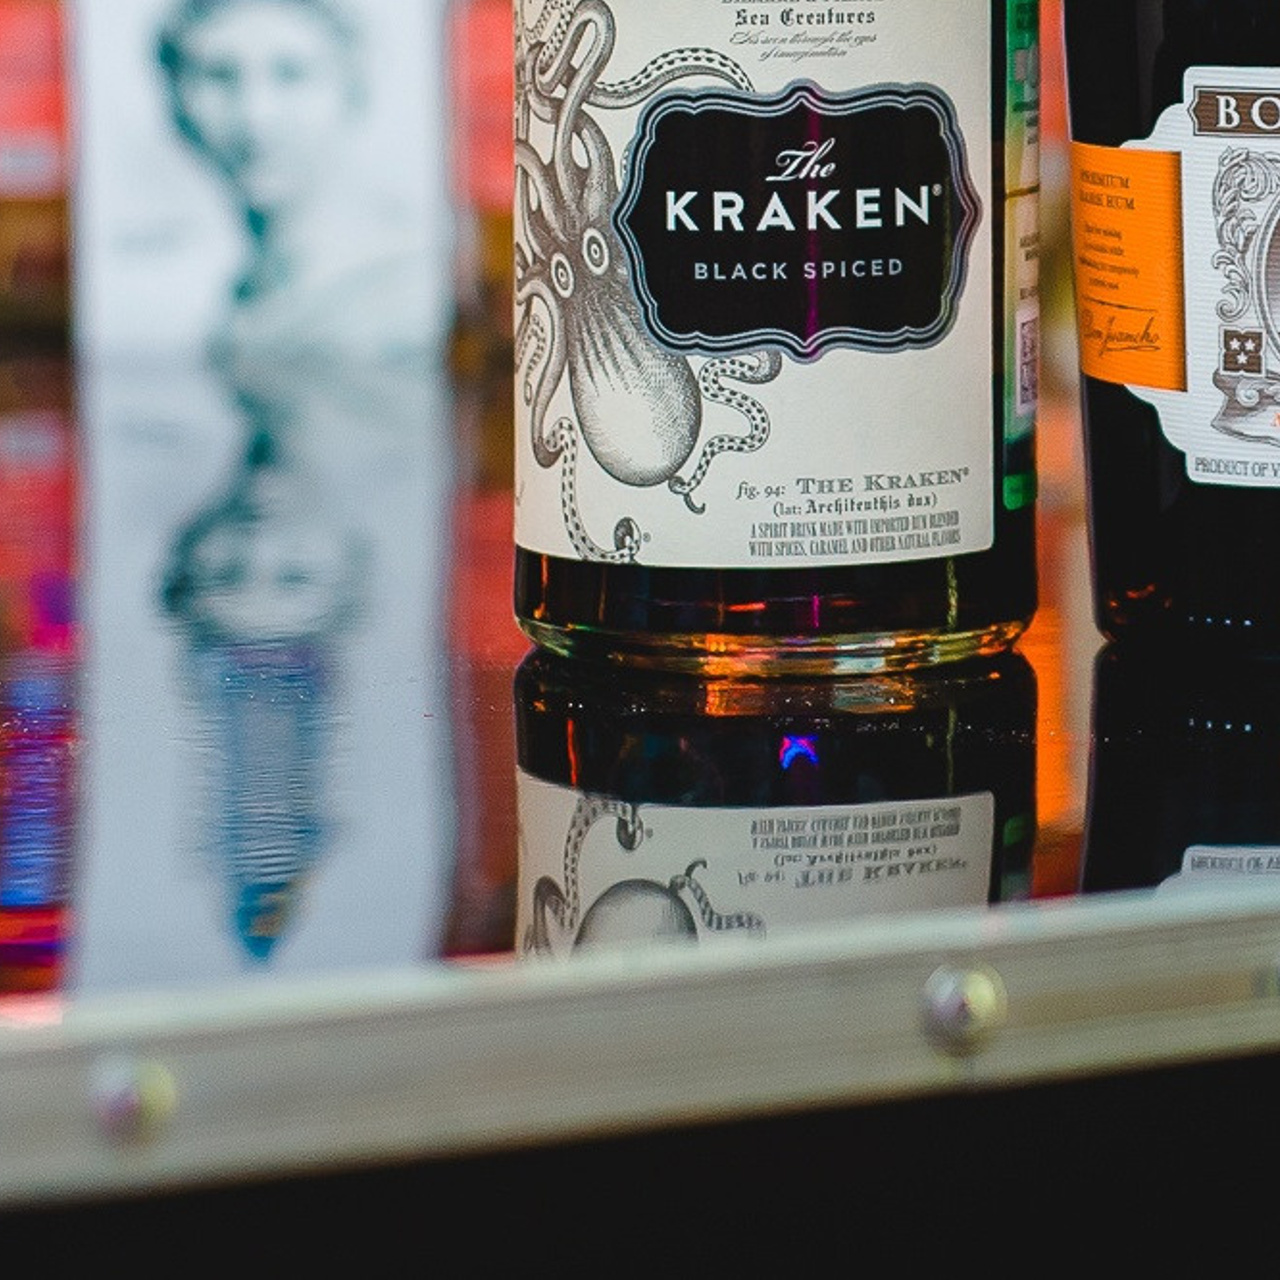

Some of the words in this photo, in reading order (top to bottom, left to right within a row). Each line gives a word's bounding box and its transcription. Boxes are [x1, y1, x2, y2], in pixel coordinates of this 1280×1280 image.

[735, 8, 769, 27] Sea
[780, 7, 875, 27] Creatures
[766, 137, 837, 183] The
[694, 261, 788, 281] BLACK
[803, 258, 903, 280] SPICED
[1195, 457, 1249, 477] PRODUCT
[1250, 462, 1268, 477] OF
[736, 480, 760, 500] fig.
[764, 484, 786, 498] 94:
[796, 477, 853, 495] THE
[805, 495, 900, 515] Architeuthis
[759, 521, 788, 539] SPIRIT
[791, 521, 817, 538] DRINK
[819, 520, 844, 537] MADE
[846, 519, 868, 536] WITH
[749, 540, 773, 557] WITH
[810, 537, 849, 555] CARAMEL
[850, 537, 868, 554] AND
[870, 534, 896, 552] OTHER
